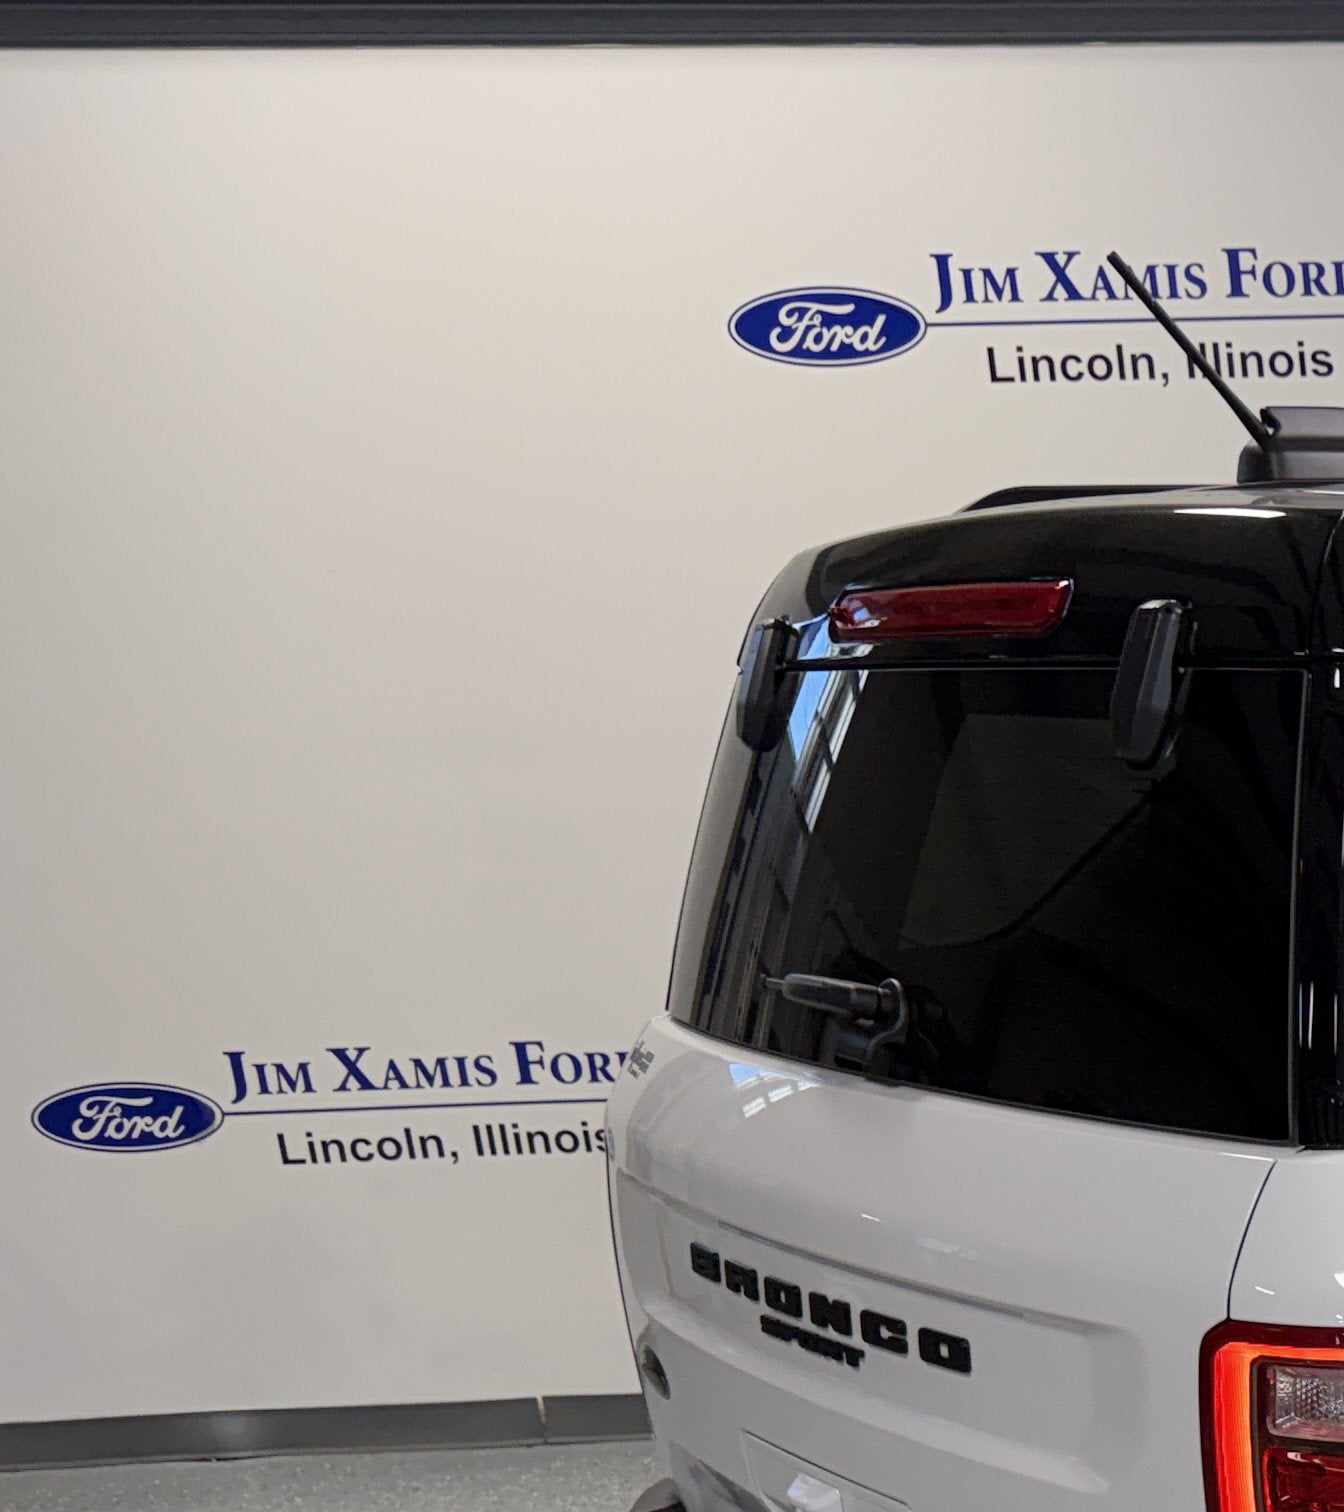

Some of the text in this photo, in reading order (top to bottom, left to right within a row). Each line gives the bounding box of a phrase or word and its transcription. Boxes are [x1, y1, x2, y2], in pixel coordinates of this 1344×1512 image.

[929, 252, 1021, 314] JIM
[1036, 250, 1208, 302] XAMIS
[770, 302, 886, 353] Ford
[987, 341, 1334, 386] Lincoln, Illinois
[222, 1051, 313, 1104] JIM
[325, 1046, 498, 1094] XAMIS
[70, 1095, 185, 1141] Ford
[277, 1127, 459, 1166] Lincoln,
[690, 1241, 973, 1374] BRONCO
[760, 1314, 865, 1369] SPORT
